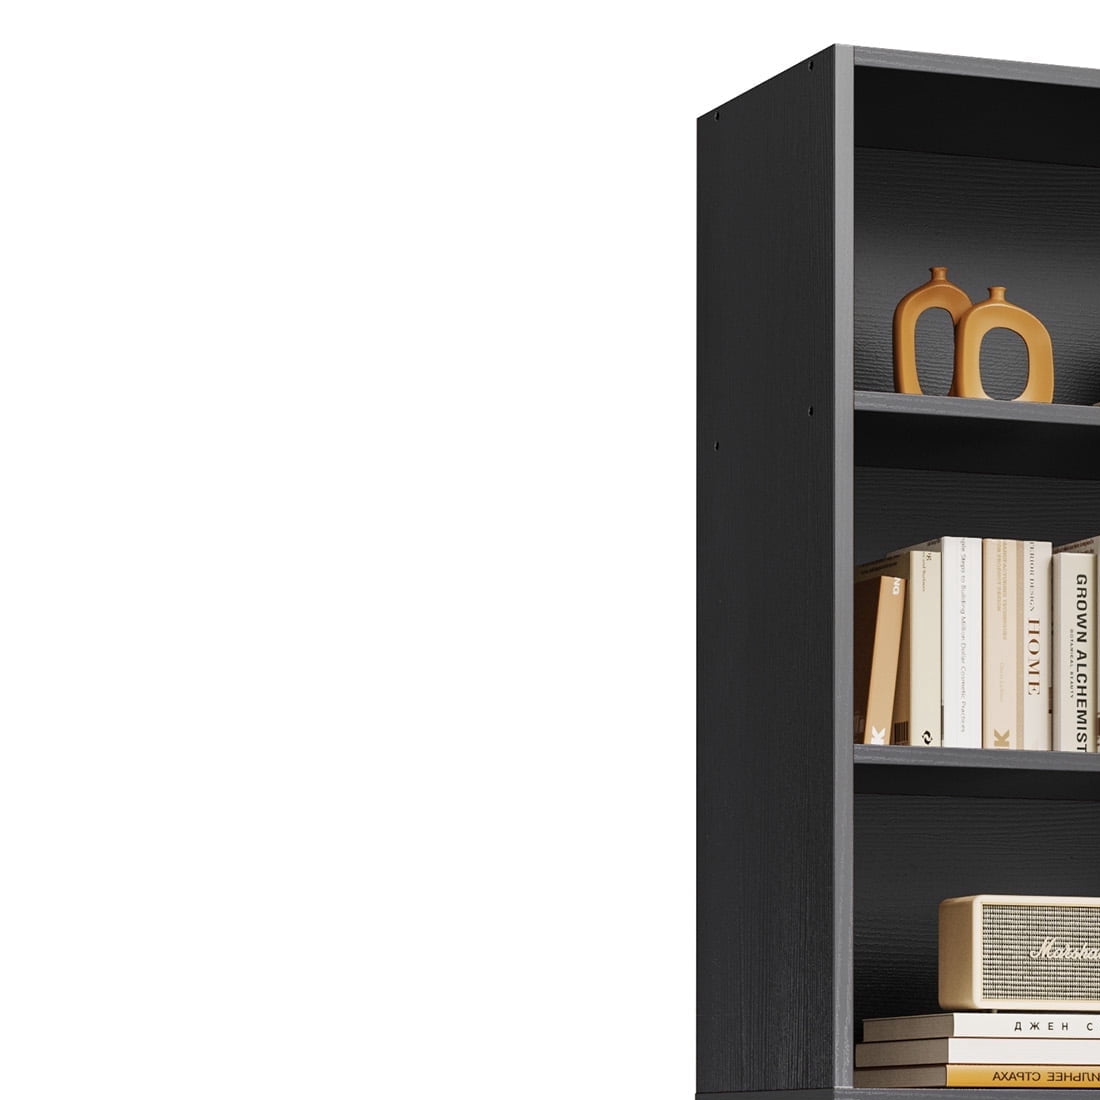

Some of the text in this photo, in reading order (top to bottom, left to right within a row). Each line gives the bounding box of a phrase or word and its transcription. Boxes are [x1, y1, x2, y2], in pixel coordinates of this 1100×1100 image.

[960, 554, 968, 573] Steps
[961, 575, 967, 583] to
[960, 585, 968, 614] Building
[1028, 619, 1040, 695] HOME
[1076, 574, 1088, 752] GROWN ALCHEMIST
[960, 666, 968, 699] Cosmetic
[960, 701, 968, 733] Practices
[1014, 1022, 1069, 1032] ДЖЕН
